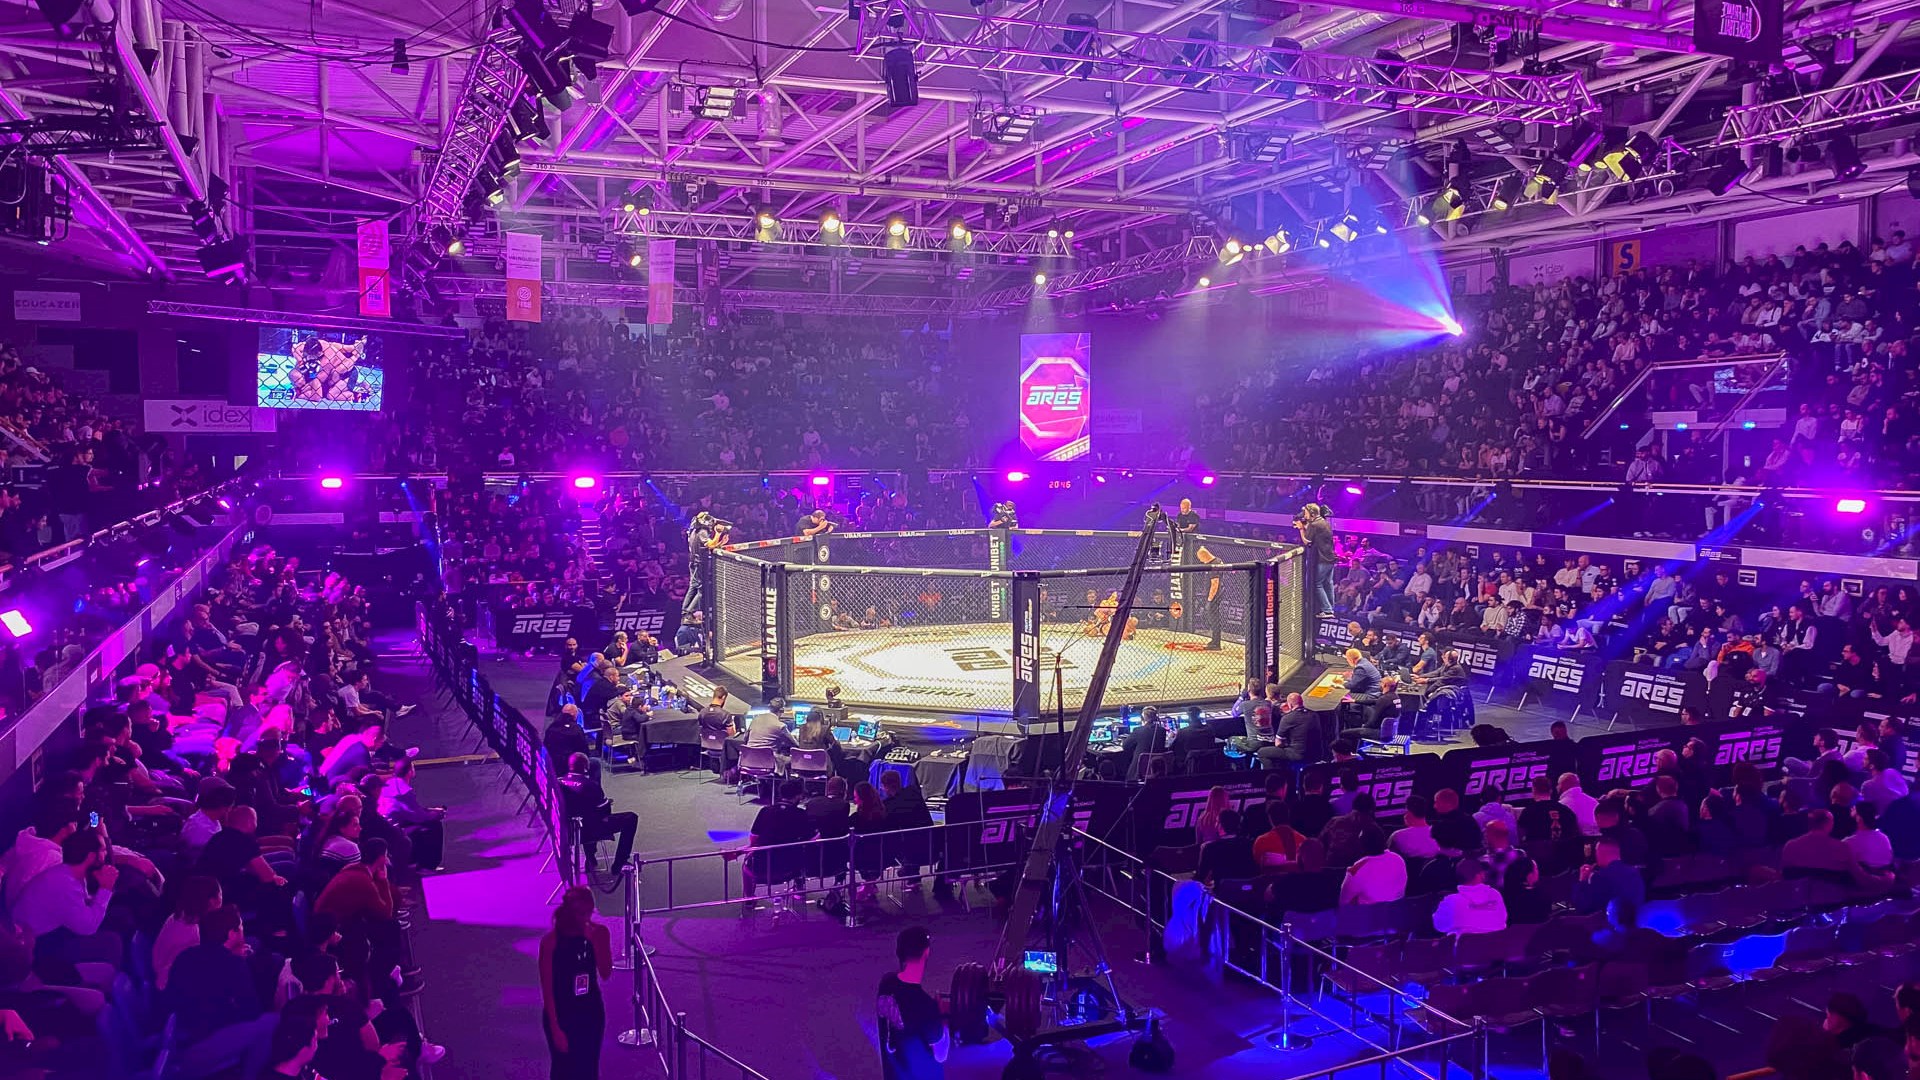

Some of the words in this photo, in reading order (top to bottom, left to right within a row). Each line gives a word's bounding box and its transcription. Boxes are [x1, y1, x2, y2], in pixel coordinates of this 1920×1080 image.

[1620, 243, 1634, 269] S
[203, 405, 250, 423] idex
[990, 535, 1000, 572] UNIBET
[991, 580, 1001, 619] UNIBET
